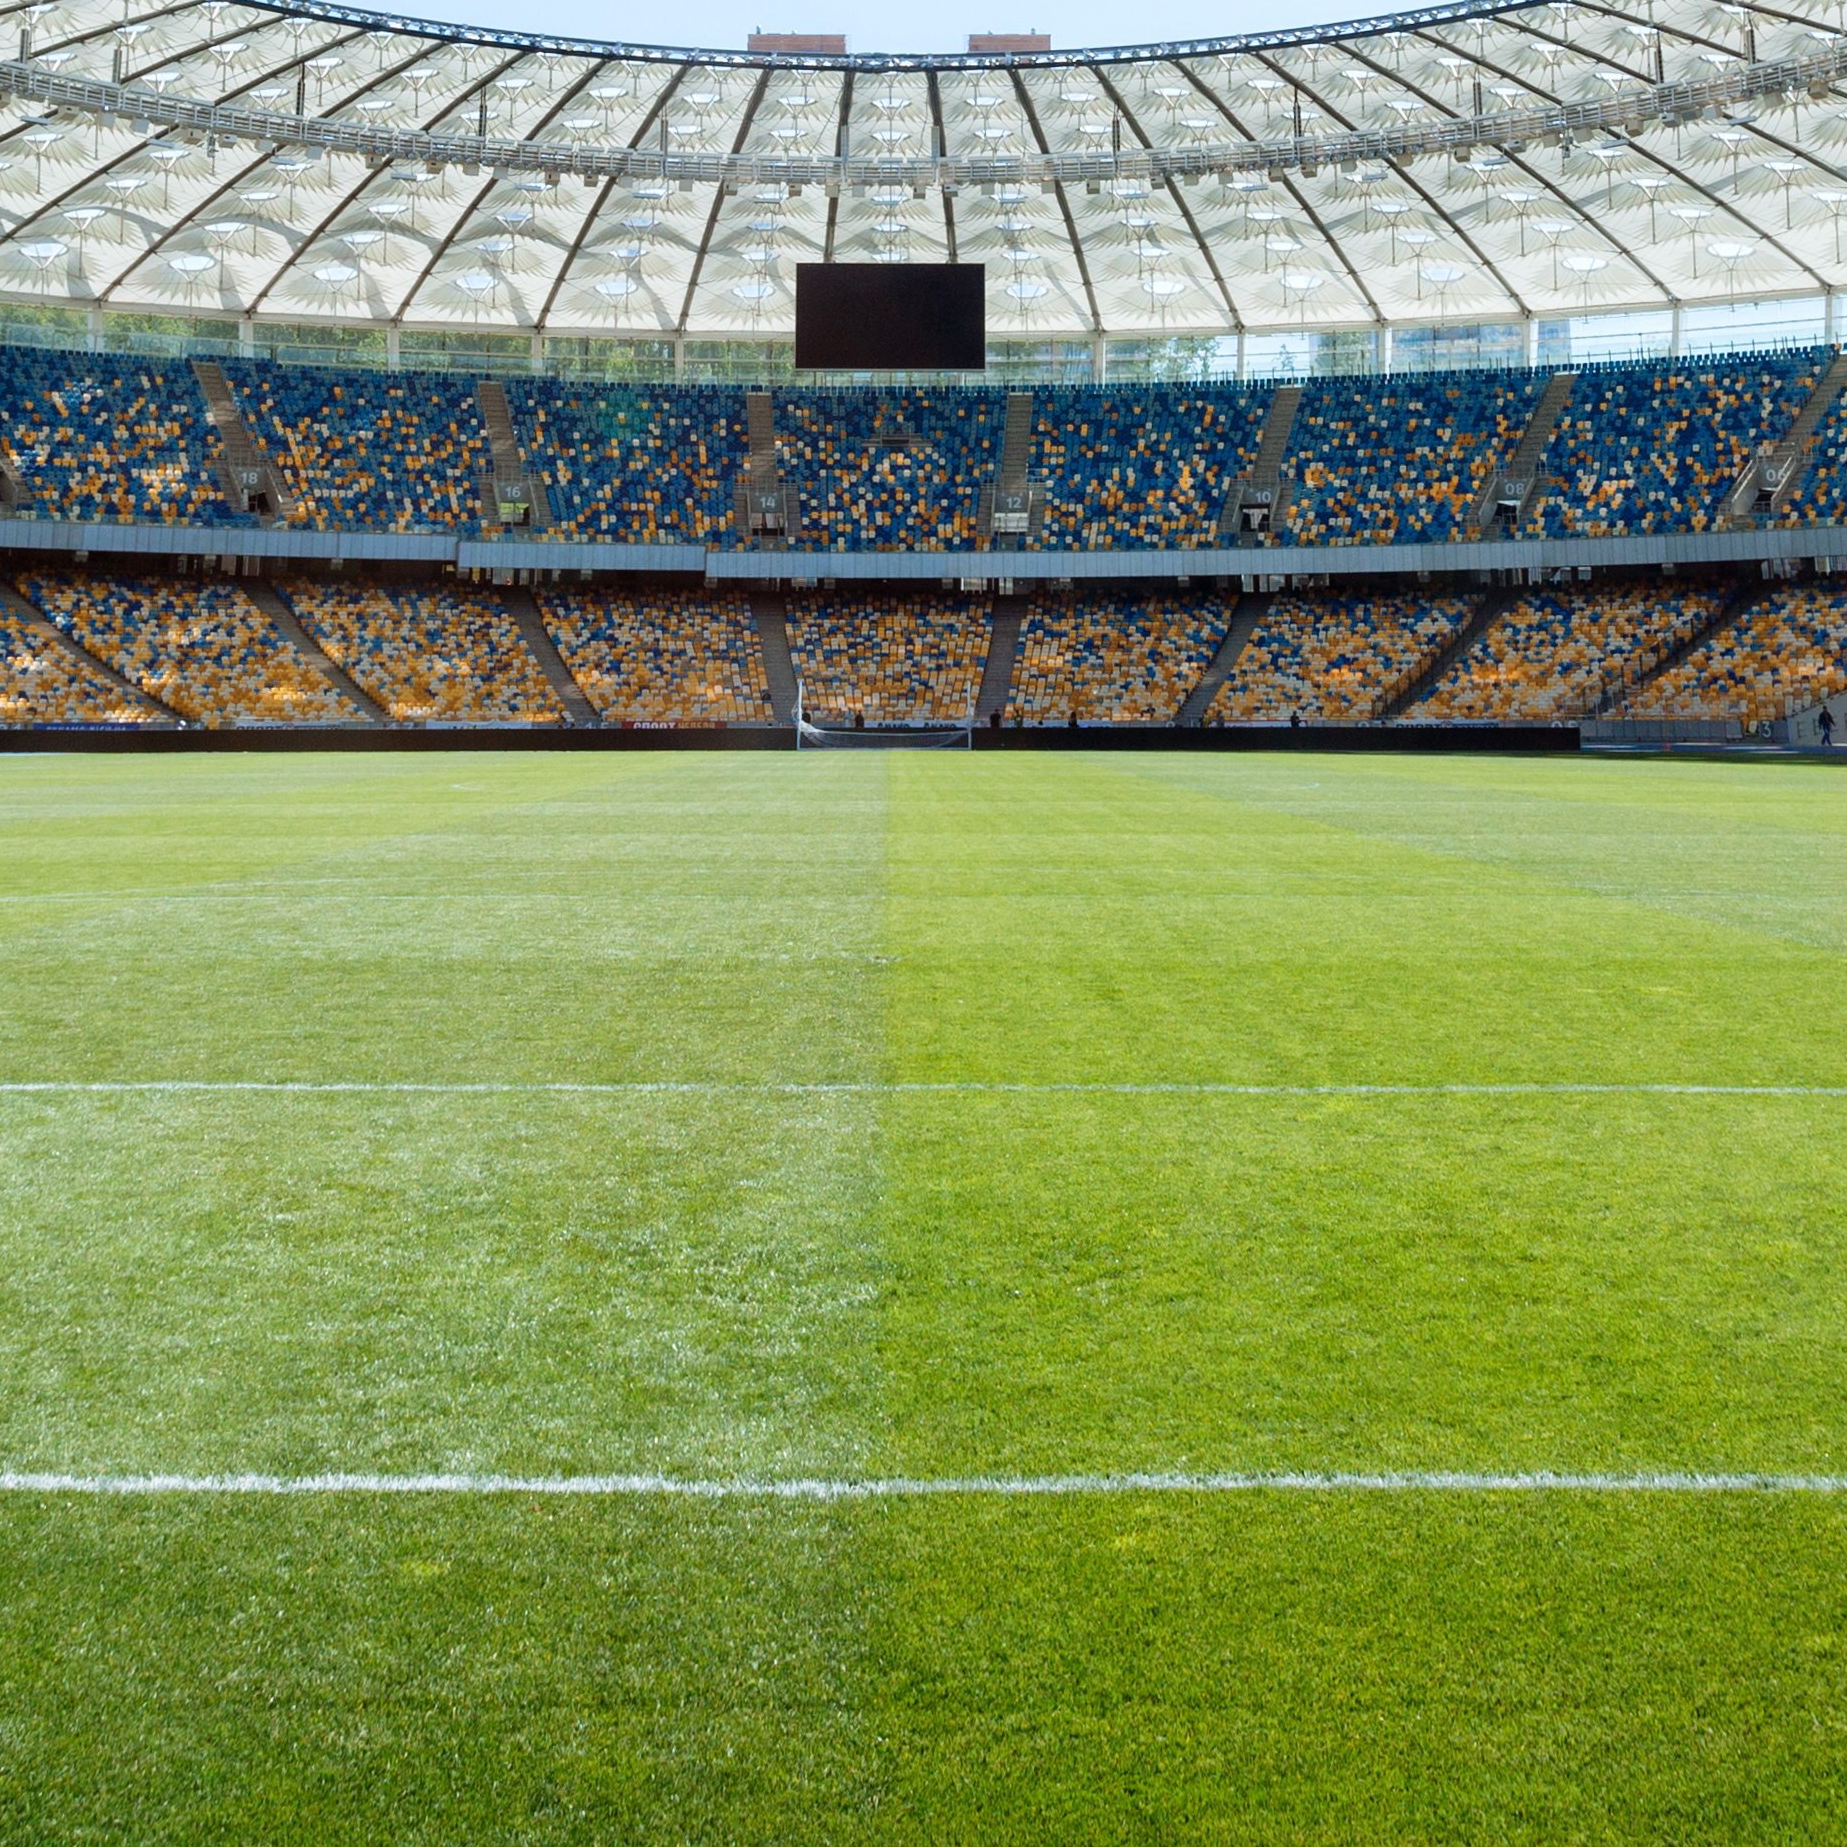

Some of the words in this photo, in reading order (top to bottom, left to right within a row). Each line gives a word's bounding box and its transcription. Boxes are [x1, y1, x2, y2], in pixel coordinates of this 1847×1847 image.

[241, 471, 259, 485] 18
[1766, 468, 1788, 482] 06
[505, 485, 521, 498] 16
[1506, 482, 1525, 496] 08
[760, 496, 776, 509] 14
[1006, 497, 1022, 509] 12
[1255, 491, 1272, 504] 10
